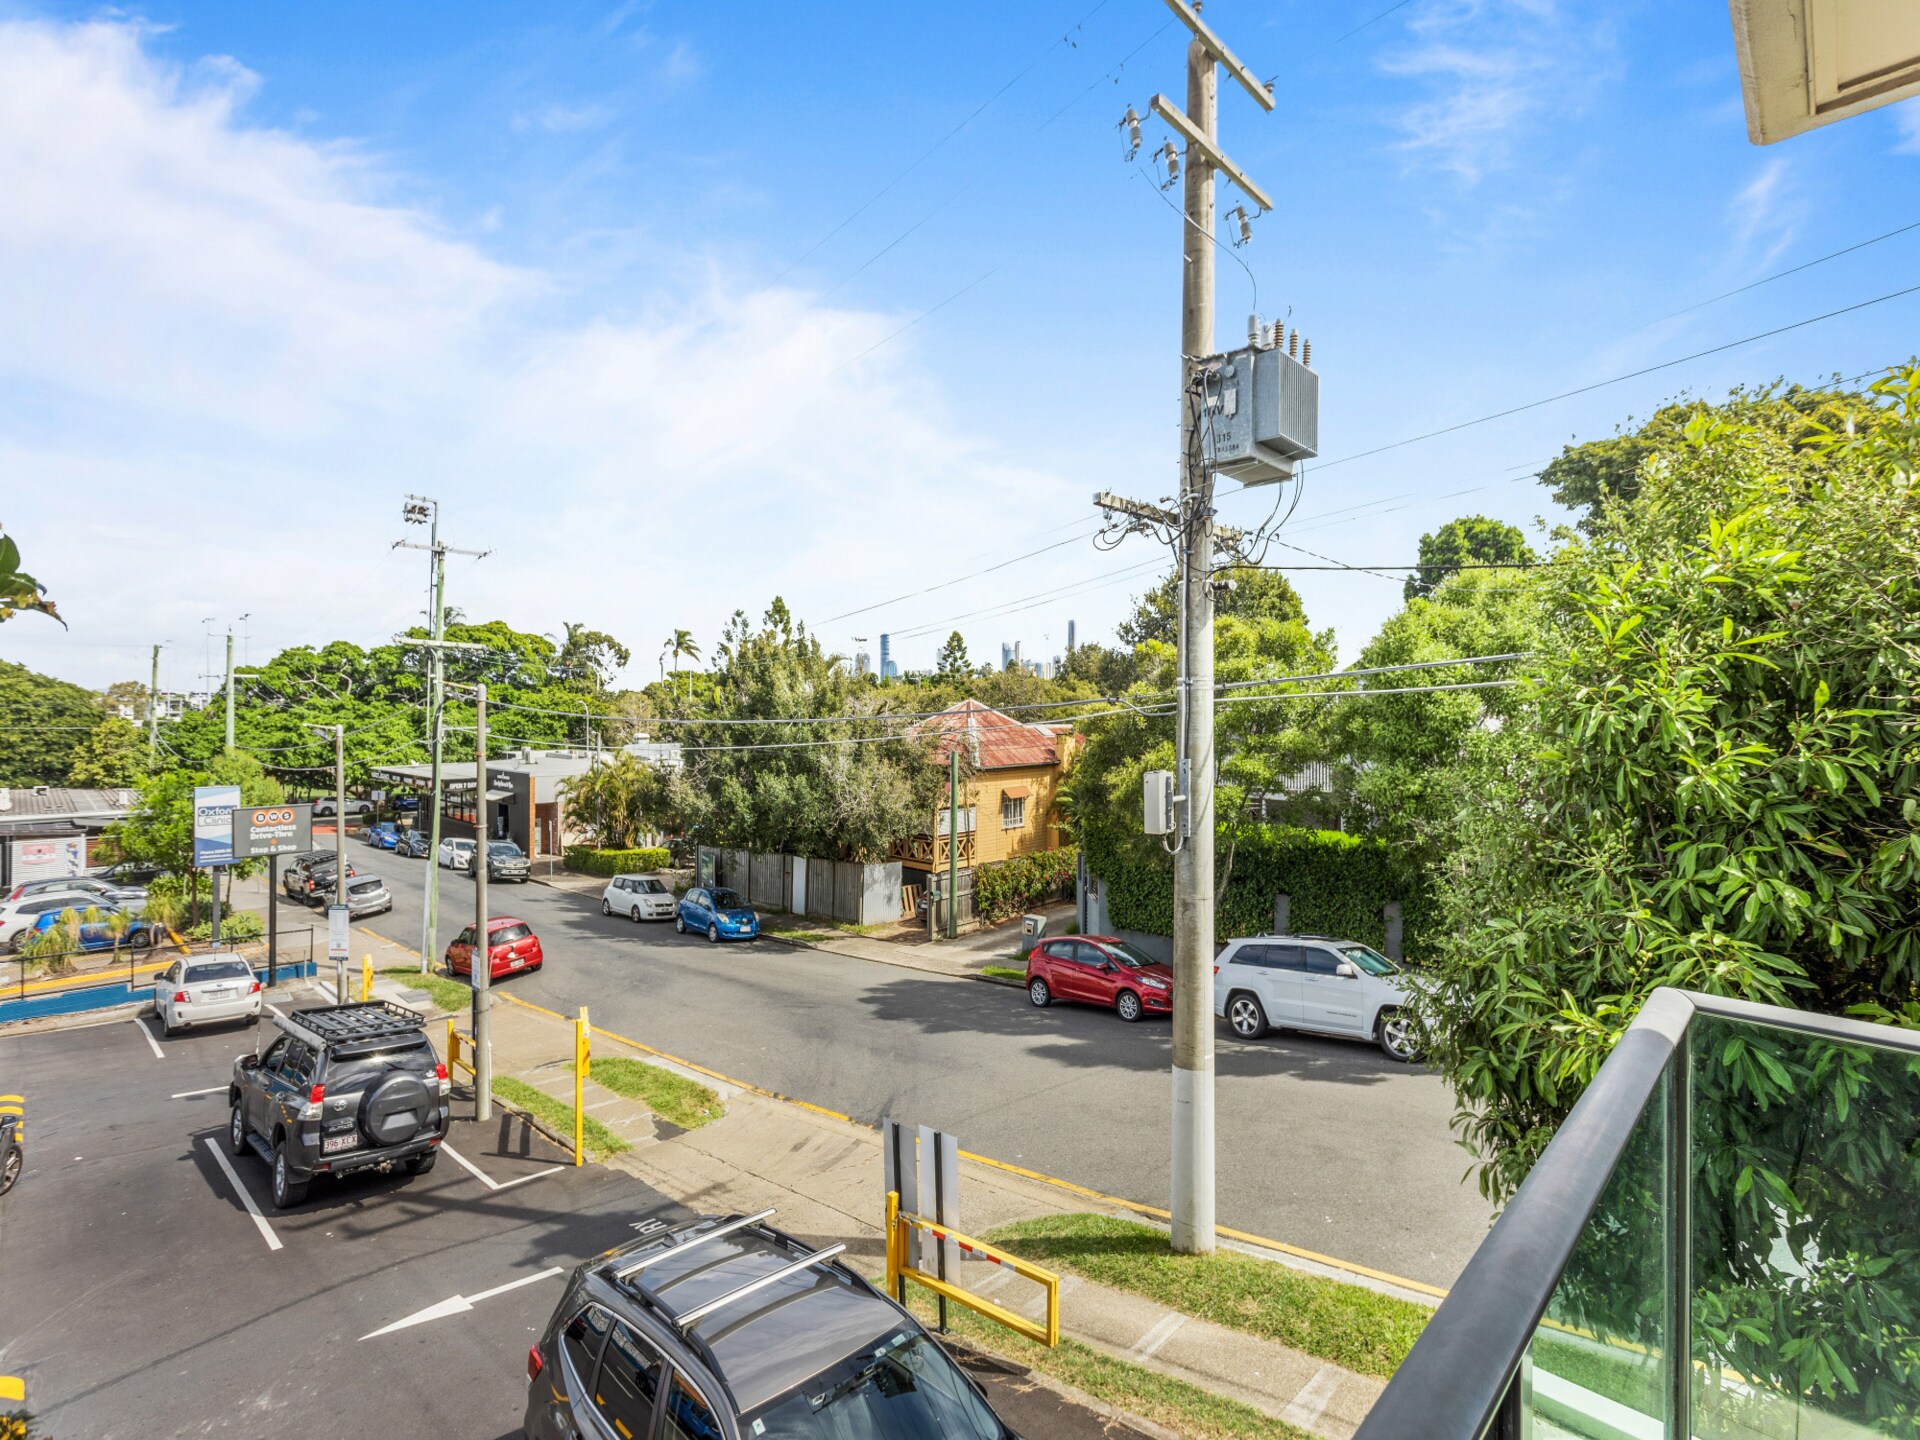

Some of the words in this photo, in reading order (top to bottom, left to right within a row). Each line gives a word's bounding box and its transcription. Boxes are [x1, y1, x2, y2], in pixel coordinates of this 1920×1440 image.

[1217, 432, 1232, 443] 315
[449, 782, 463, 790] OPEN
[467, 781, 478, 789] DAY
[199, 806, 235, 816] Oxfor
[204, 816, 232, 825] Clinic
[250, 824, 297, 833] Contactless
[250, 831, 294, 840] Drive-Thru
[277, 844, 297, 852] Shop
[628, 1218, 668, 1235] RY
